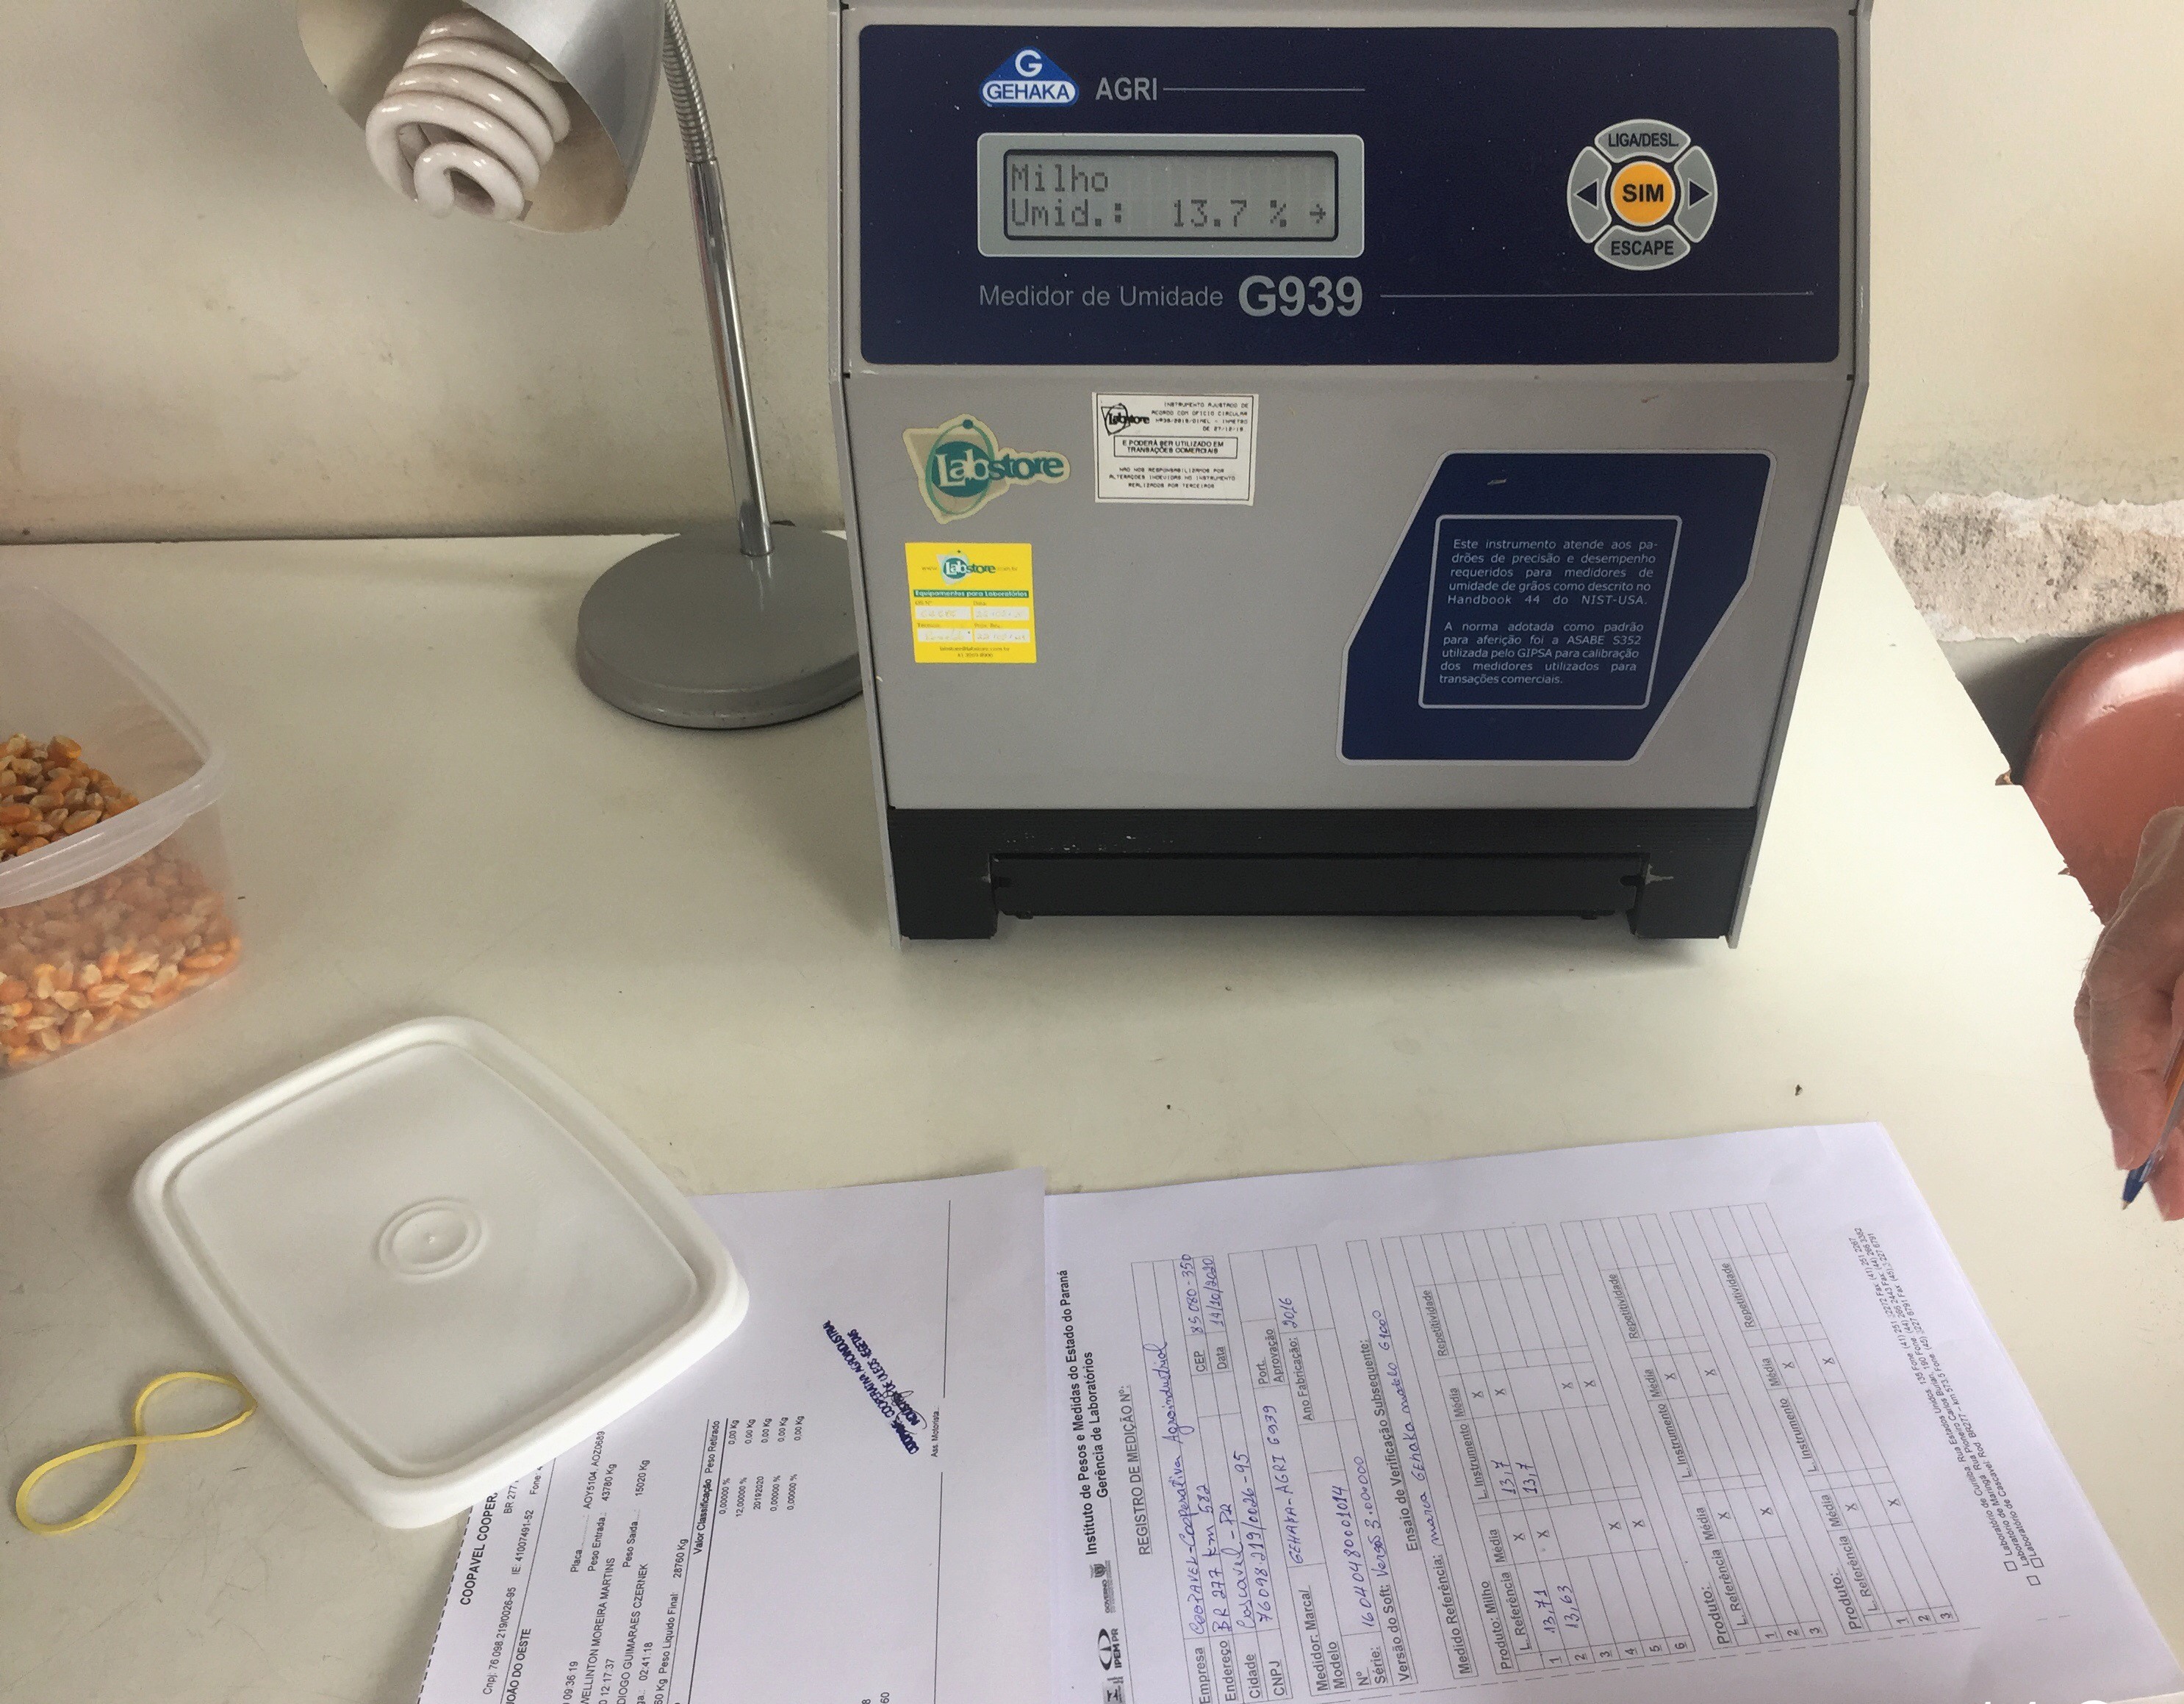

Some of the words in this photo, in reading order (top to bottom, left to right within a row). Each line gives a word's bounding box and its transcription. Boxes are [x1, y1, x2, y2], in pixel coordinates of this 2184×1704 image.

[1015, 49, 1042, 77] G
[986, 84, 1070, 101] GEHAKA
[1096, 77, 1158, 101] AGRI
[1608, 132, 1679, 147] LIGA/DESL.
[1011, 163, 1109, 193] Milho
[1622, 183, 1664, 203] SIM
[1011, 198, 1122, 227] Umid.:
[1174, 199, 1247, 228] 13.7
[1270, 199, 1287, 228] %
[1611, 240, 1674, 256] ESCAPE
[980, 285, 1074, 306] Medidor
[1082, 285, 1110, 306] de
[1121, 285, 1224, 306] Umidade
[1239, 276, 1363, 317] G939
[935, 449, 1065, 487] Labstore
[1451, 553, 1484, 564] drões
[1490, 553, 1505, 564] de
[1512, 553, 1560, 565] precisão
[1567, 556, 1575, 564] e
[1581, 553, 1656, 565] desempenho
[1454, 539, 1478, 549] Este
[1486, 539, 1556, 550] instrumento
[1563, 539, 1603, 550] atende
[1611, 542, 1631, 550] aos
[1639, 542, 1658, 552] pa-
[946, 561, 996, 575] Labstore
[1450, 568, 1514, 579] requeridos
[1526, 569, 1552, 579] para
[1565, 568, 1626, 578] medidores
[1639, 568, 1653, 578] de
[1448, 582, 1498, 591] umidade
[1501, 582, 1515, 592] de
[1518, 581, 1551, 593] grãos
[1587, 582, 1634, 592] descrito
[1448, 594, 1512, 604] Handbook
[1524, 595, 1540, 604] 44
[1553, 594, 1569, 604] do
[1581, 594, 1648, 605] NIST-USA.
[1443, 636, 1469, 647] para
[1476, 635, 1522, 647] aferição
[1529, 635, 1545, 645] foi
[1567, 636, 1605, 645] ASABE
[1613, 636, 1642, 645] S352
[1444, 622, 1453, 631] A
[1507, 622, 1554, 632] adotada
[1563, 624, 1595, 632] como
[1603, 622, 1644, 633] padrão
[1440, 661, 1461, 671] dos
[1473, 661, 1533, 671] medidores
[1545, 661, 1599, 671] utilizados
[1611, 664, 1637, 673] para
[1442, 648, 1488, 658] utilizada
[1490, 648, 1515, 660] pelo
[1517, 649, 1552, 658] GIPSA
[1555, 650, 1580, 660] para
[1582, 648, 1639, 661] calibração
[1440, 675, 1499, 686] transações
[1501, 675, 1563, 684] comerciais.
[1057, 1270, 1071, 1306] Paraná
[1721, 1262, 1755, 1328] Repetitividade
[1062, 1309, 1072, 1322] do
[1609, 1273, 1639, 1340] Repetitividade
[1423, 1290, 1447, 1356] Repetitividade
[1064, 1325, 1077, 1363] Estado
[1216, 1346, 1227, 1370] Data
[1265, 1329, 1283, 1383] Aprovação
[1068, 1365, 1079, 1379] do
[1194, 1351, 1206, 1373] CEP
[1255, 1361, 1268, 1384] Port.
[1289, 1337, 1308, 1397] Fabricação:
[1084, 1352, 1100, 1423] Laboratórios
[1449, 1387, 1465, 1417] Média
[1071, 1383, 1083, 1431] Medidas
[1298, 1399, 1313, 1420] Ano
[707, 1420, 719, 1451] Retirado
[1091, 1427, 1102, 1440] de
[1120, 1406, 1139, 1462] MEDIÇÃO
[1659, 1403, 1687, 1464] Instrumento
[639, 1459, 650, 1472] Kg
[705, 1452, 716, 1473] Peso
[1078, 1444, 1089, 1481] Pesos
[1379, 1420, 1402, 1486] Verificação
[1460, 1424, 1484, 1486] Instrumento
[635, 1473, 647, 1497] 15020
[1093, 1444, 1108, 1498] Gerência
[1129, 1466, 1141, 1483] DE
[503, 1500, 514, 1514] BR
[507, 1485, 518, 1500] 277
[697, 1478, 712, 1529] Classificação
[753, 1476, 764, 1510] 20192020
[1080, 1484, 1091, 1499] de
[1395, 1489, 1407, 1505] de
[588, 1551, 598, 1572] Peso
[601, 1476, 613, 1502] 43780
[607, 1463, 617, 1475] Kg
[1082, 1503, 1098, 1555] Instituto
[1131, 1487, 1151, 1555] REGISTRO
[1399, 1507, 1418, 1551] Ensaio
[1986, 1510, 2013, 1556] Laboratório
[514, 1509, 534, 1562] 41007491-52
[677, 1539, 689, 1550] Kg
[693, 1530, 705, 1555] Valor
[1488, 1529, 1506, 1562] Média
[2005, 1520, 2030, 1567] Laboratório
[2010, 1511, 2036, 1557] Laboratório
[622, 1547, 633, 1568] Peso
[673, 1552, 685, 1578] 28760
[1839, 1536, 1872, 1598] Referência
[459, 1543, 486, 1606] COOPAVEL
[633, 1563, 648, 1608] CZERNEK
[1433, 1554, 1456, 1624] Referência:
[1713, 1549, 1742, 1612] Referência
[592, 1602, 608, 1650] MOREIRA
[600, 1557, 615, 1601] MARTINS
[1382, 1584, 1395, 1615] Soft:
[1481, 1581, 1496, 1614] Milho
[1501, 1572, 1526, 1636] Referência
[1829, 1572, 1862, 1630] Produto:
[1387, 1618, 1397, 1633] do
[1700, 1586, 1730, 1645] Produto:
[517, 1628, 532, 1661] OESTE
[1111, 1628, 1118, 1642] PR
[1490, 1617, 1512, 1669] Produto:
[658, 1651, 670, 1674] Peso
[1113, 1643, 1122, 1668] IPEM
[1327, 1642, 1346, 1689] Modelo
[1395, 1636, 1412, 1682] Versão
[1454, 1628, 1470, 1675] Medido
[515, 1661, 525, 1679] DO
[656, 1678, 668, 1692] Kg
[1195, 1647, 1211, 1704] Empresa
[1220, 1640, 1236, 1701] Endereço
[1245, 1654, 1261, 1699] Cidade
[1269, 1661, 1285, 1697] CNPJ
